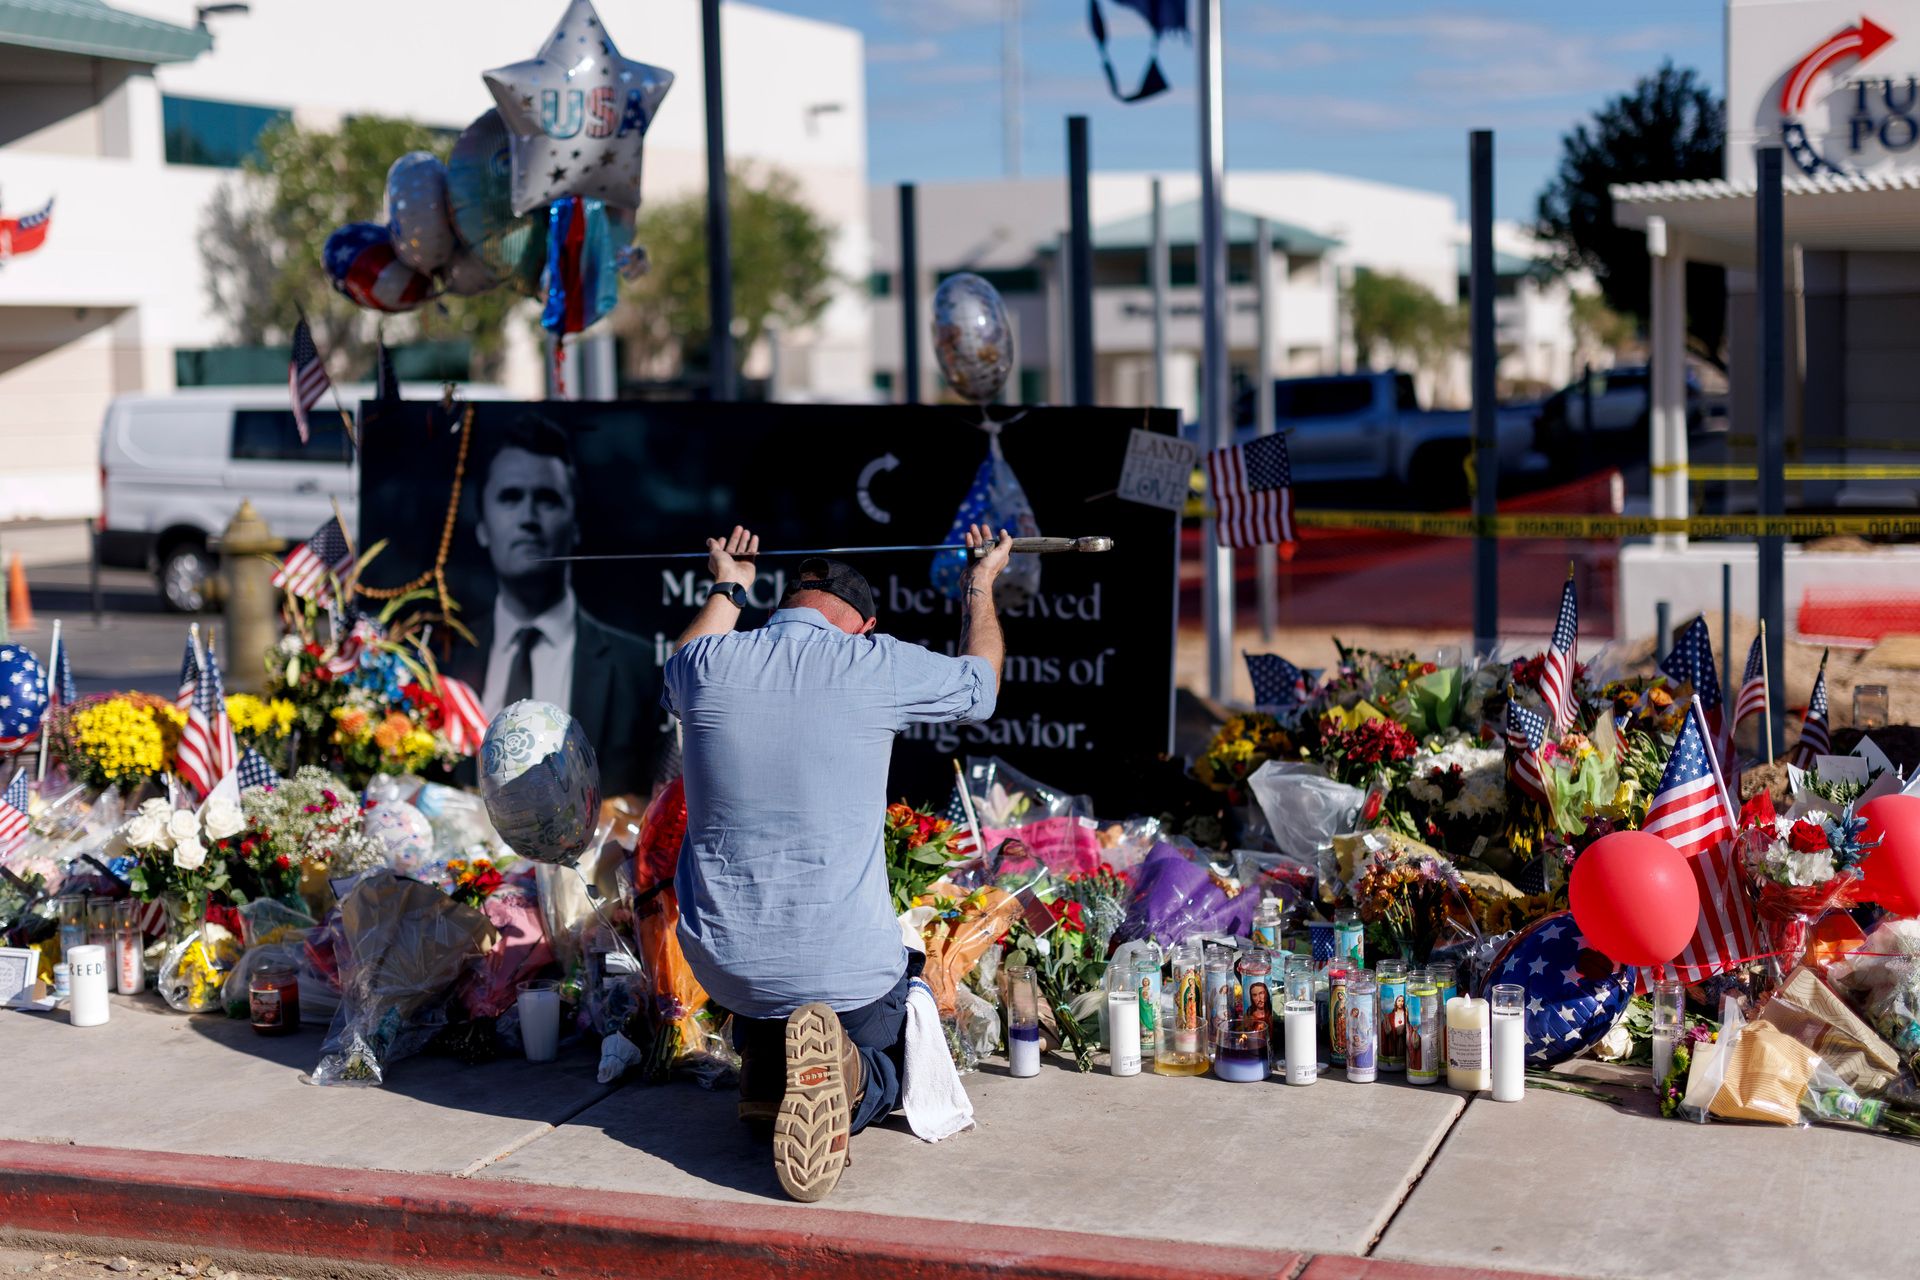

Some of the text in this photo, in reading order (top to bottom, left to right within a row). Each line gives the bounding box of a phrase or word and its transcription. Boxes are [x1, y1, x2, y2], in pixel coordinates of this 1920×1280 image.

[541, 85, 647, 140] USA
[1131, 433, 1195, 464] LAND
[1122, 472, 1185, 505] LOVE
[661, 569, 710, 607] Ma
[889, 574, 937, 615] be
[1005, 648, 1117, 687] ms of
[965, 712, 1095, 751] Savior.
[69, 962, 105, 977] REED
